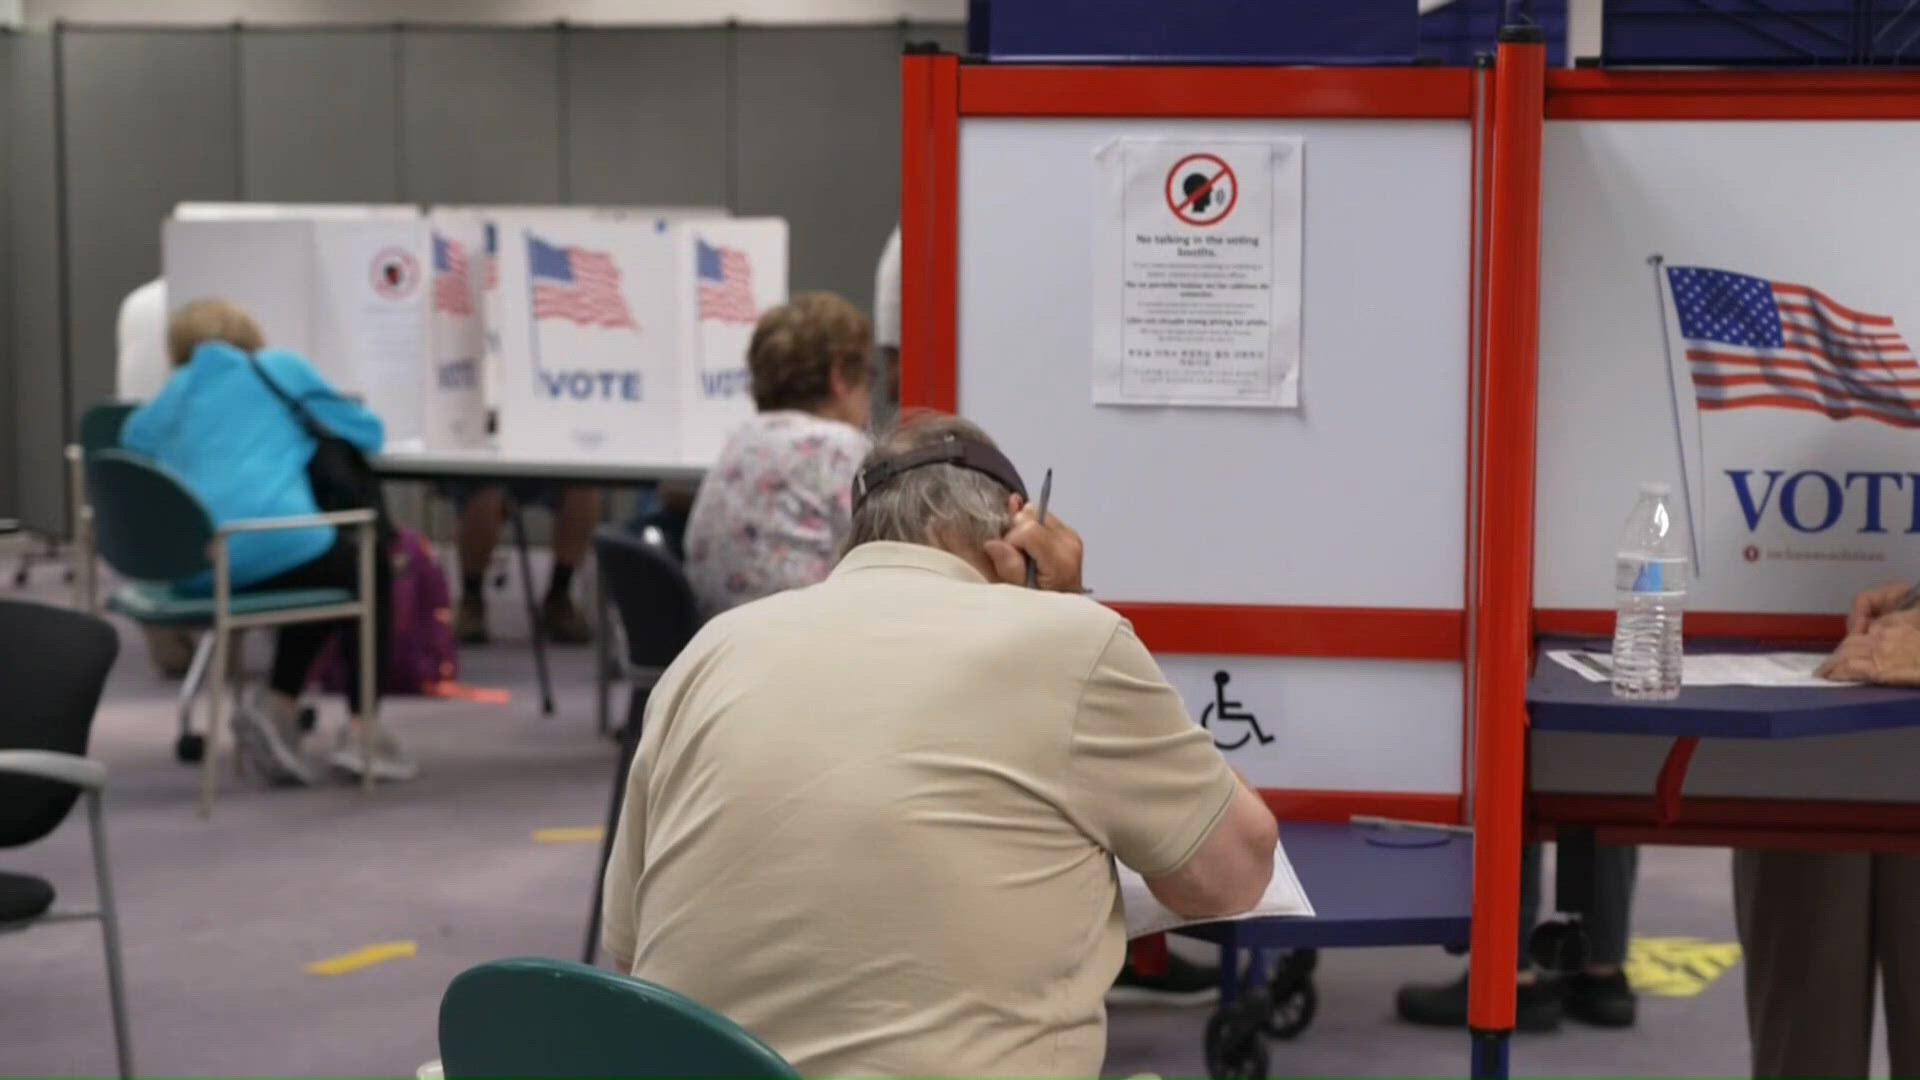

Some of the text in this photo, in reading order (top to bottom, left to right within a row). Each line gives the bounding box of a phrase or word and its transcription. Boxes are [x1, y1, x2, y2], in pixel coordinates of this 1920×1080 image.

[1137, 234, 1259, 247] No talking in the voting
[539, 370, 641, 400] VOTE
